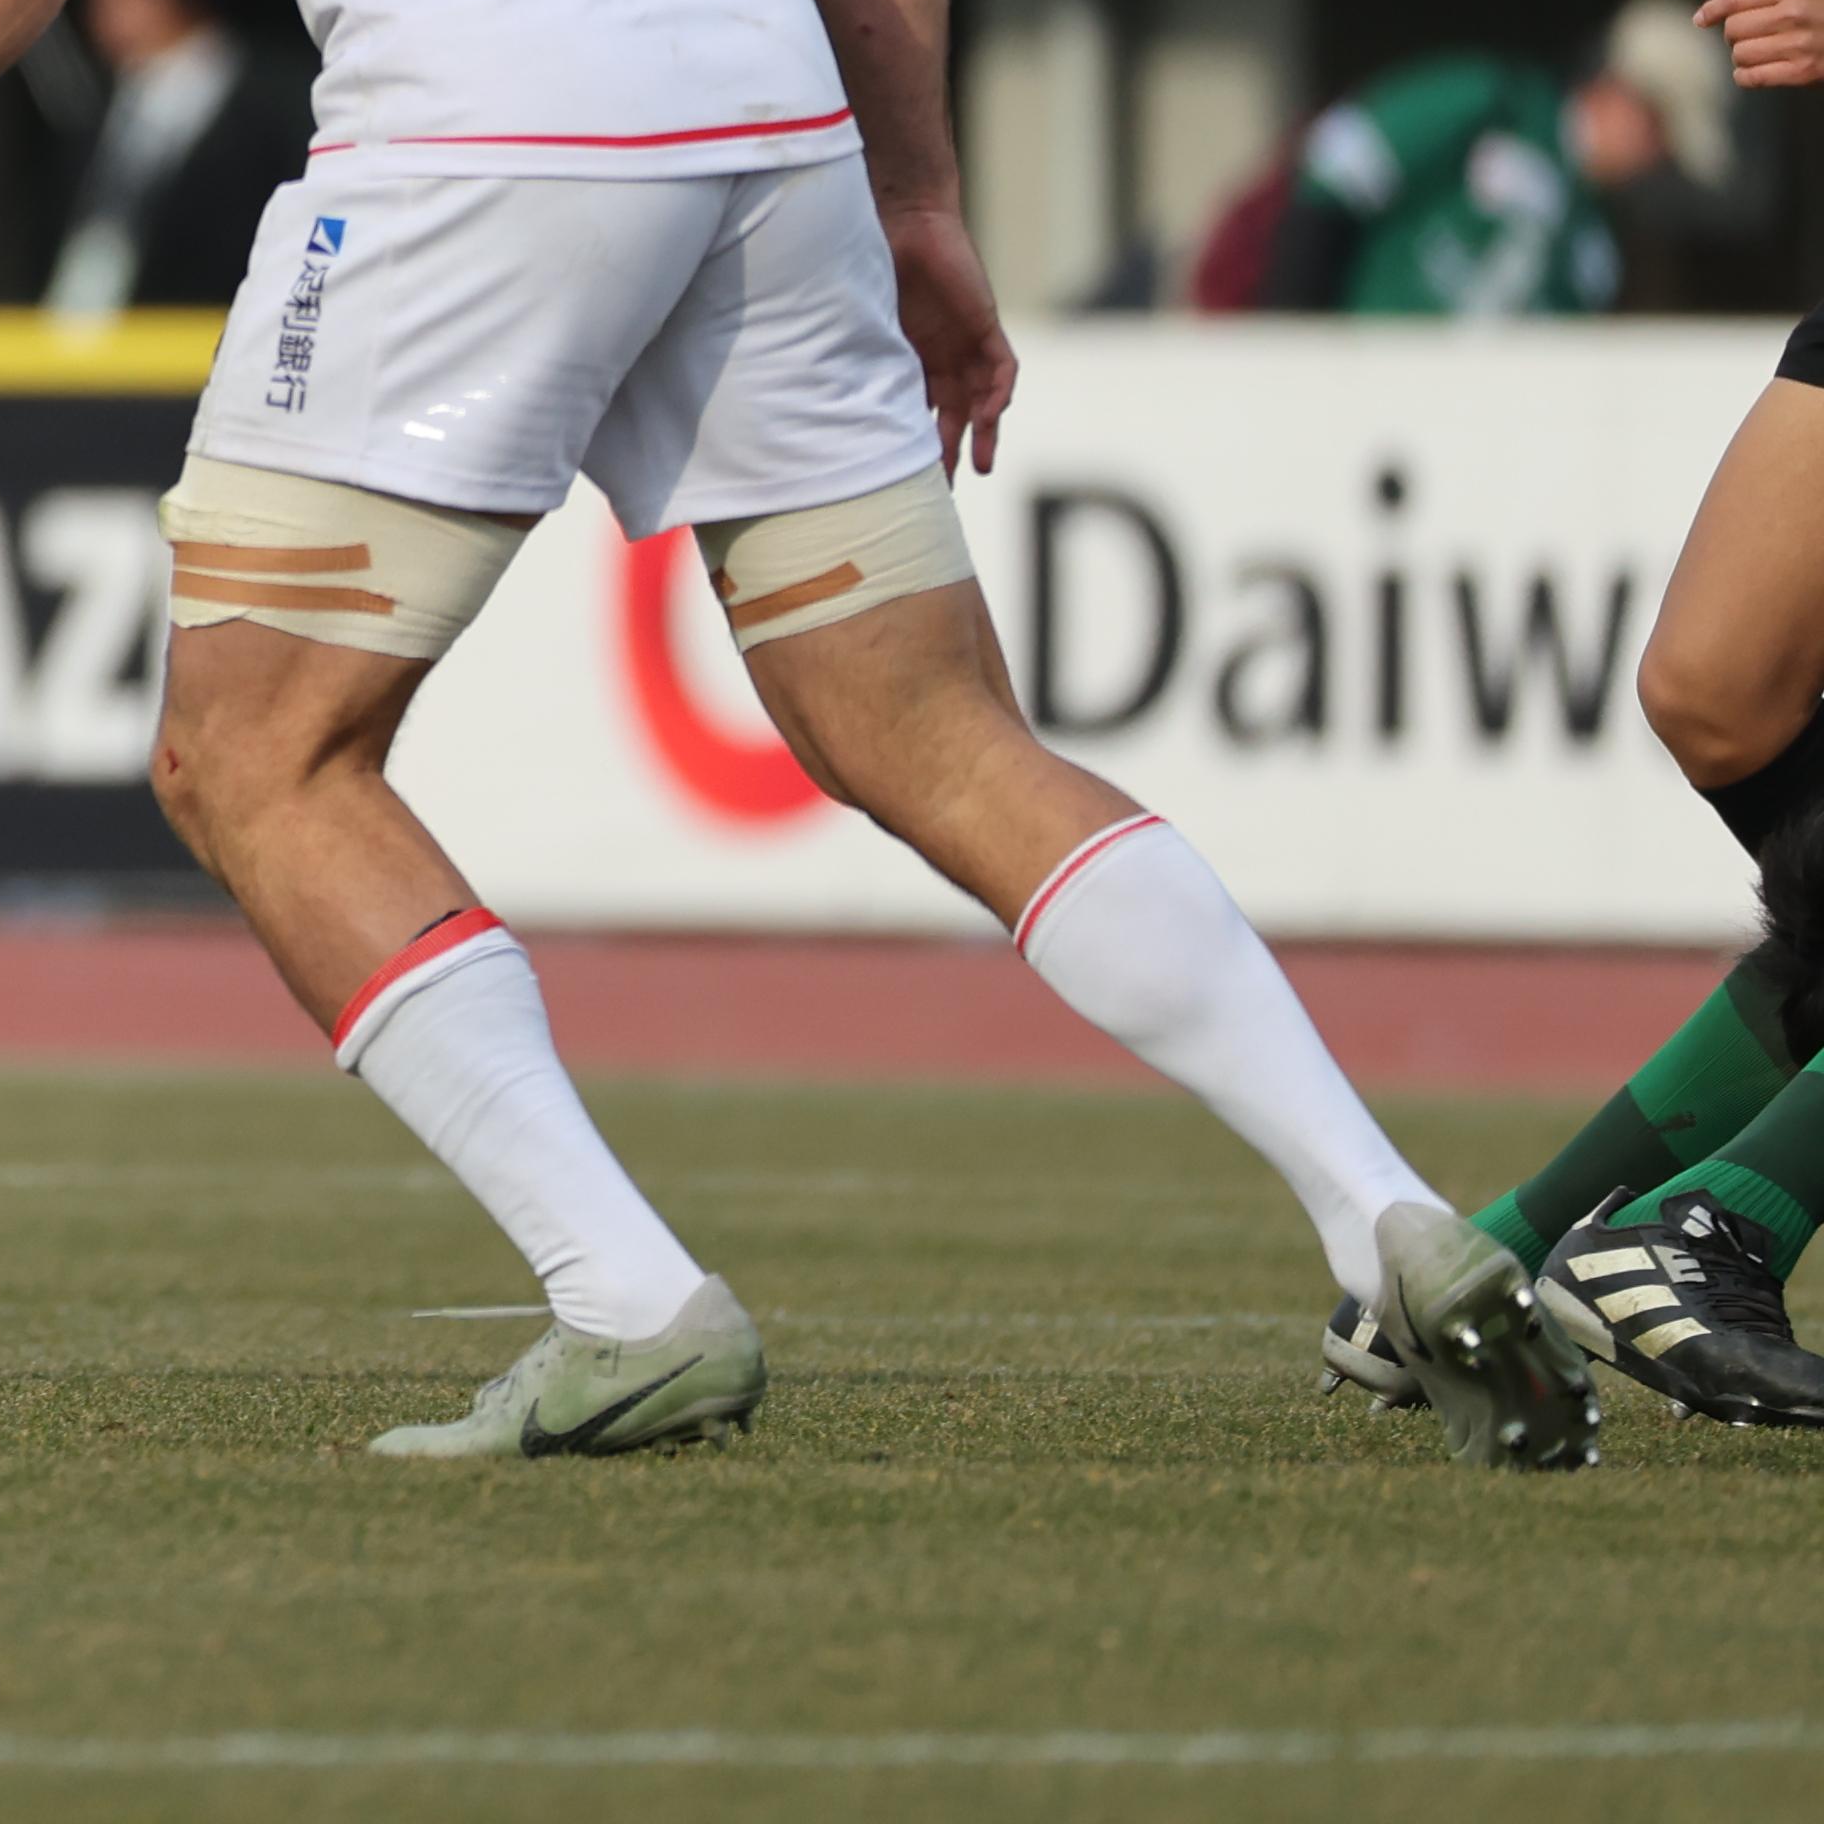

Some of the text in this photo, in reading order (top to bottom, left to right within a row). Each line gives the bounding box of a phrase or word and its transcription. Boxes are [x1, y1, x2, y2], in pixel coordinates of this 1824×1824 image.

[266, 259, 332, 413] 足利銀行
[1028, 464, 1640, 746] Daiw
